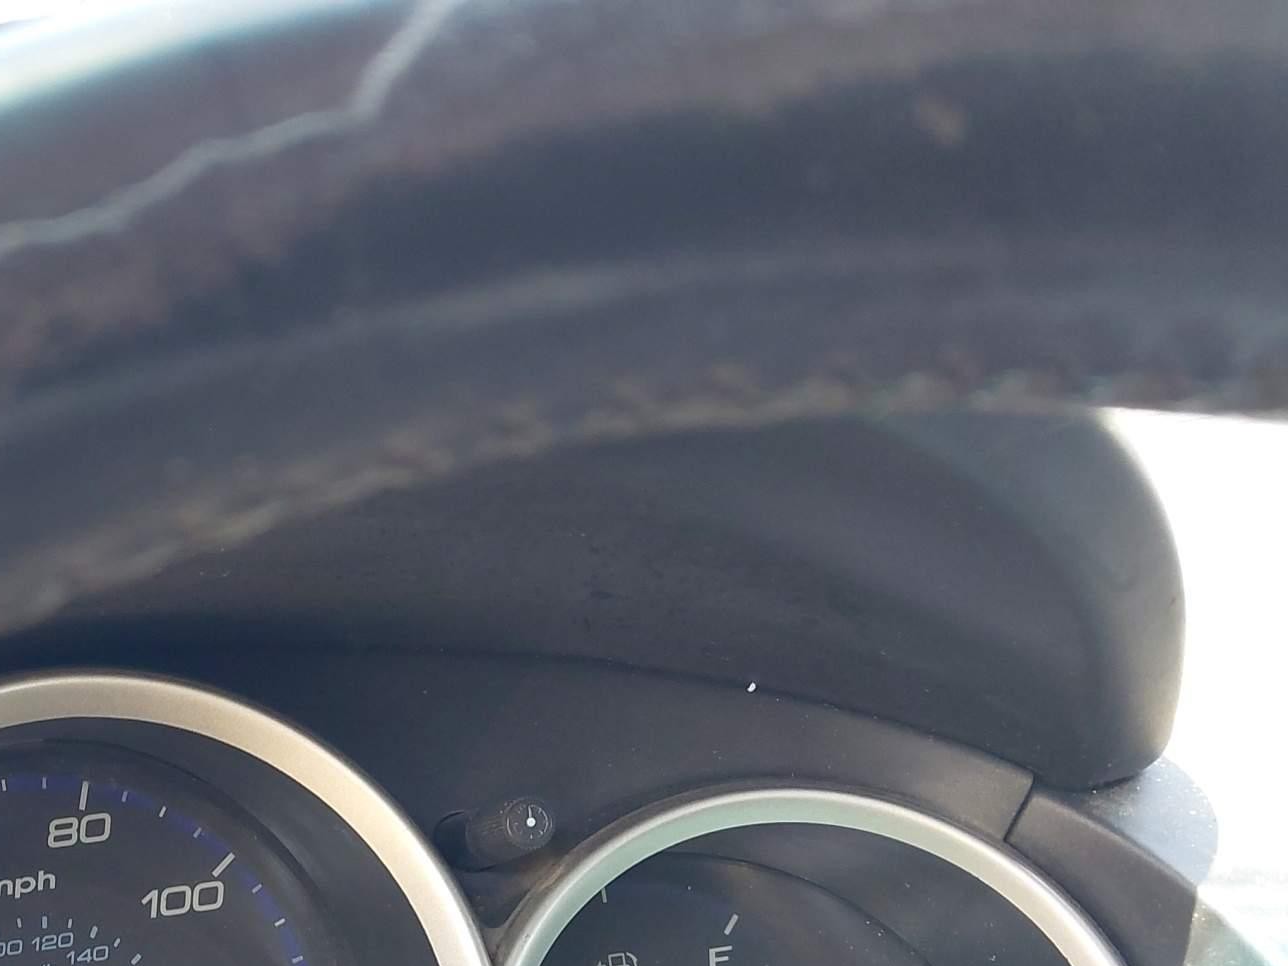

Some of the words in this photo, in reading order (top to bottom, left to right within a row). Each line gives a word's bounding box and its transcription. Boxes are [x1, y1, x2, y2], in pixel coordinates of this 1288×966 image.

[47, 813, 111, 848] 80
[141, 880, 225, 918] 100
[31, 931, 74, 952] 120
[66, 944, 109, 966] 140
